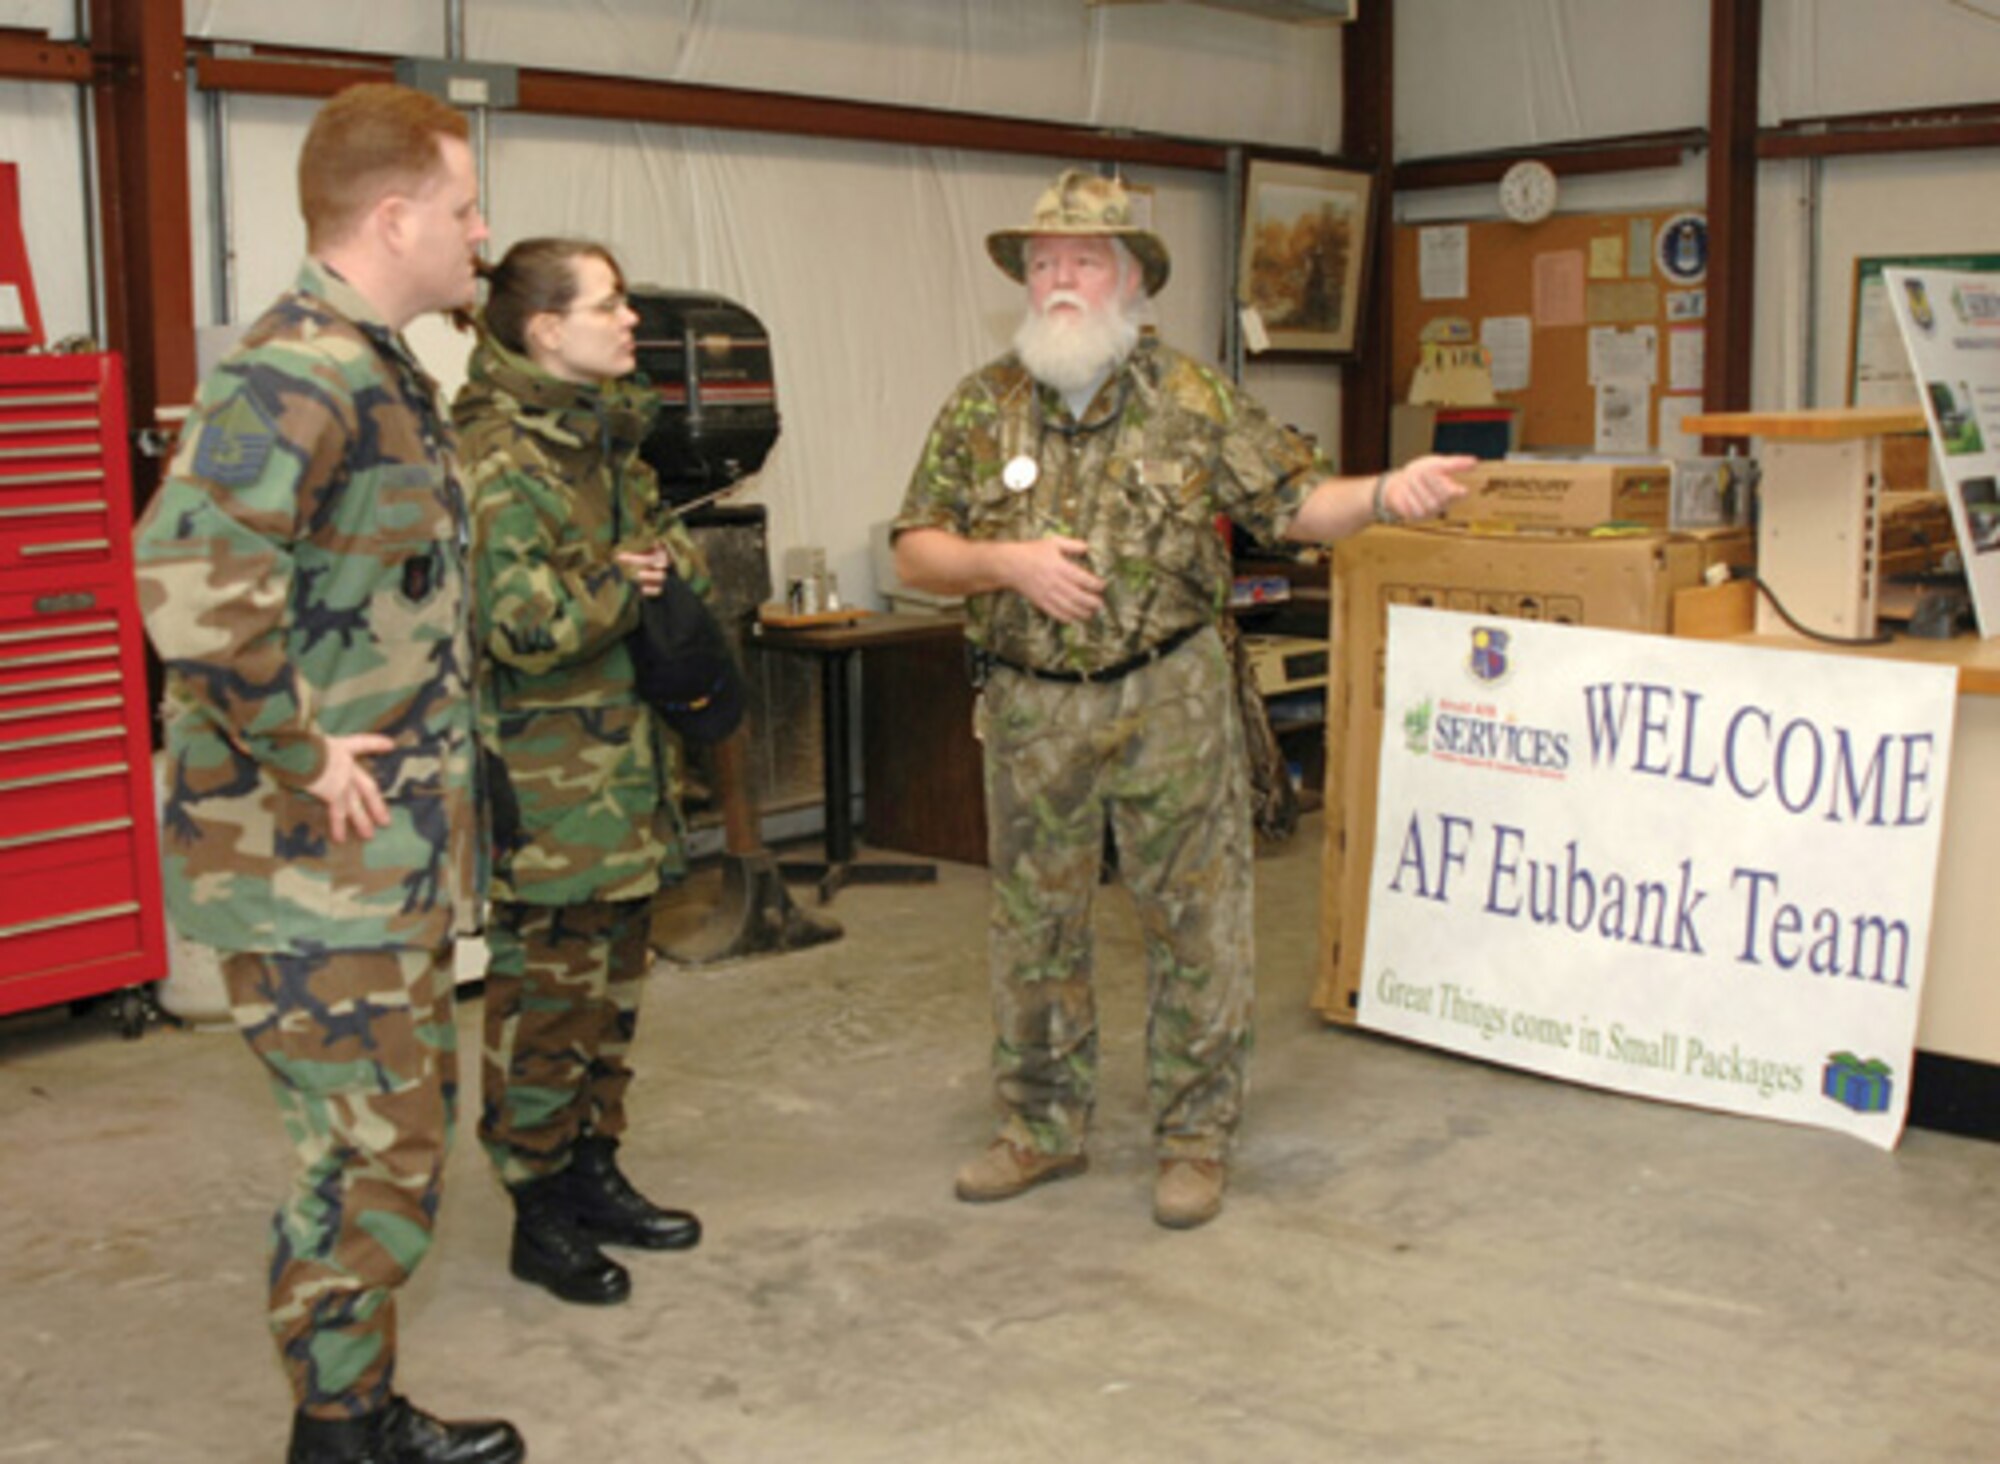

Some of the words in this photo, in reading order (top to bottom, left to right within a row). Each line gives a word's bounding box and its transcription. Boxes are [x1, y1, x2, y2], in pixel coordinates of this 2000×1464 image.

[1433, 712, 1570, 771] SERVICES
[1583, 682, 1934, 828] WELCOME
[1388, 809, 1473, 903] AF
[1483, 824, 1707, 955] Eubank
[1730, 867, 1909, 990] Team
[1376, 968, 1433, 1015] Great
[1439, 982, 1507, 1041] Things
[1511, 1011, 1573, 1049] come
[1578, 1014, 1600, 1056] in
[1606, 1022, 1678, 1072] Small
[1684, 1035, 1804, 1099] Packages
